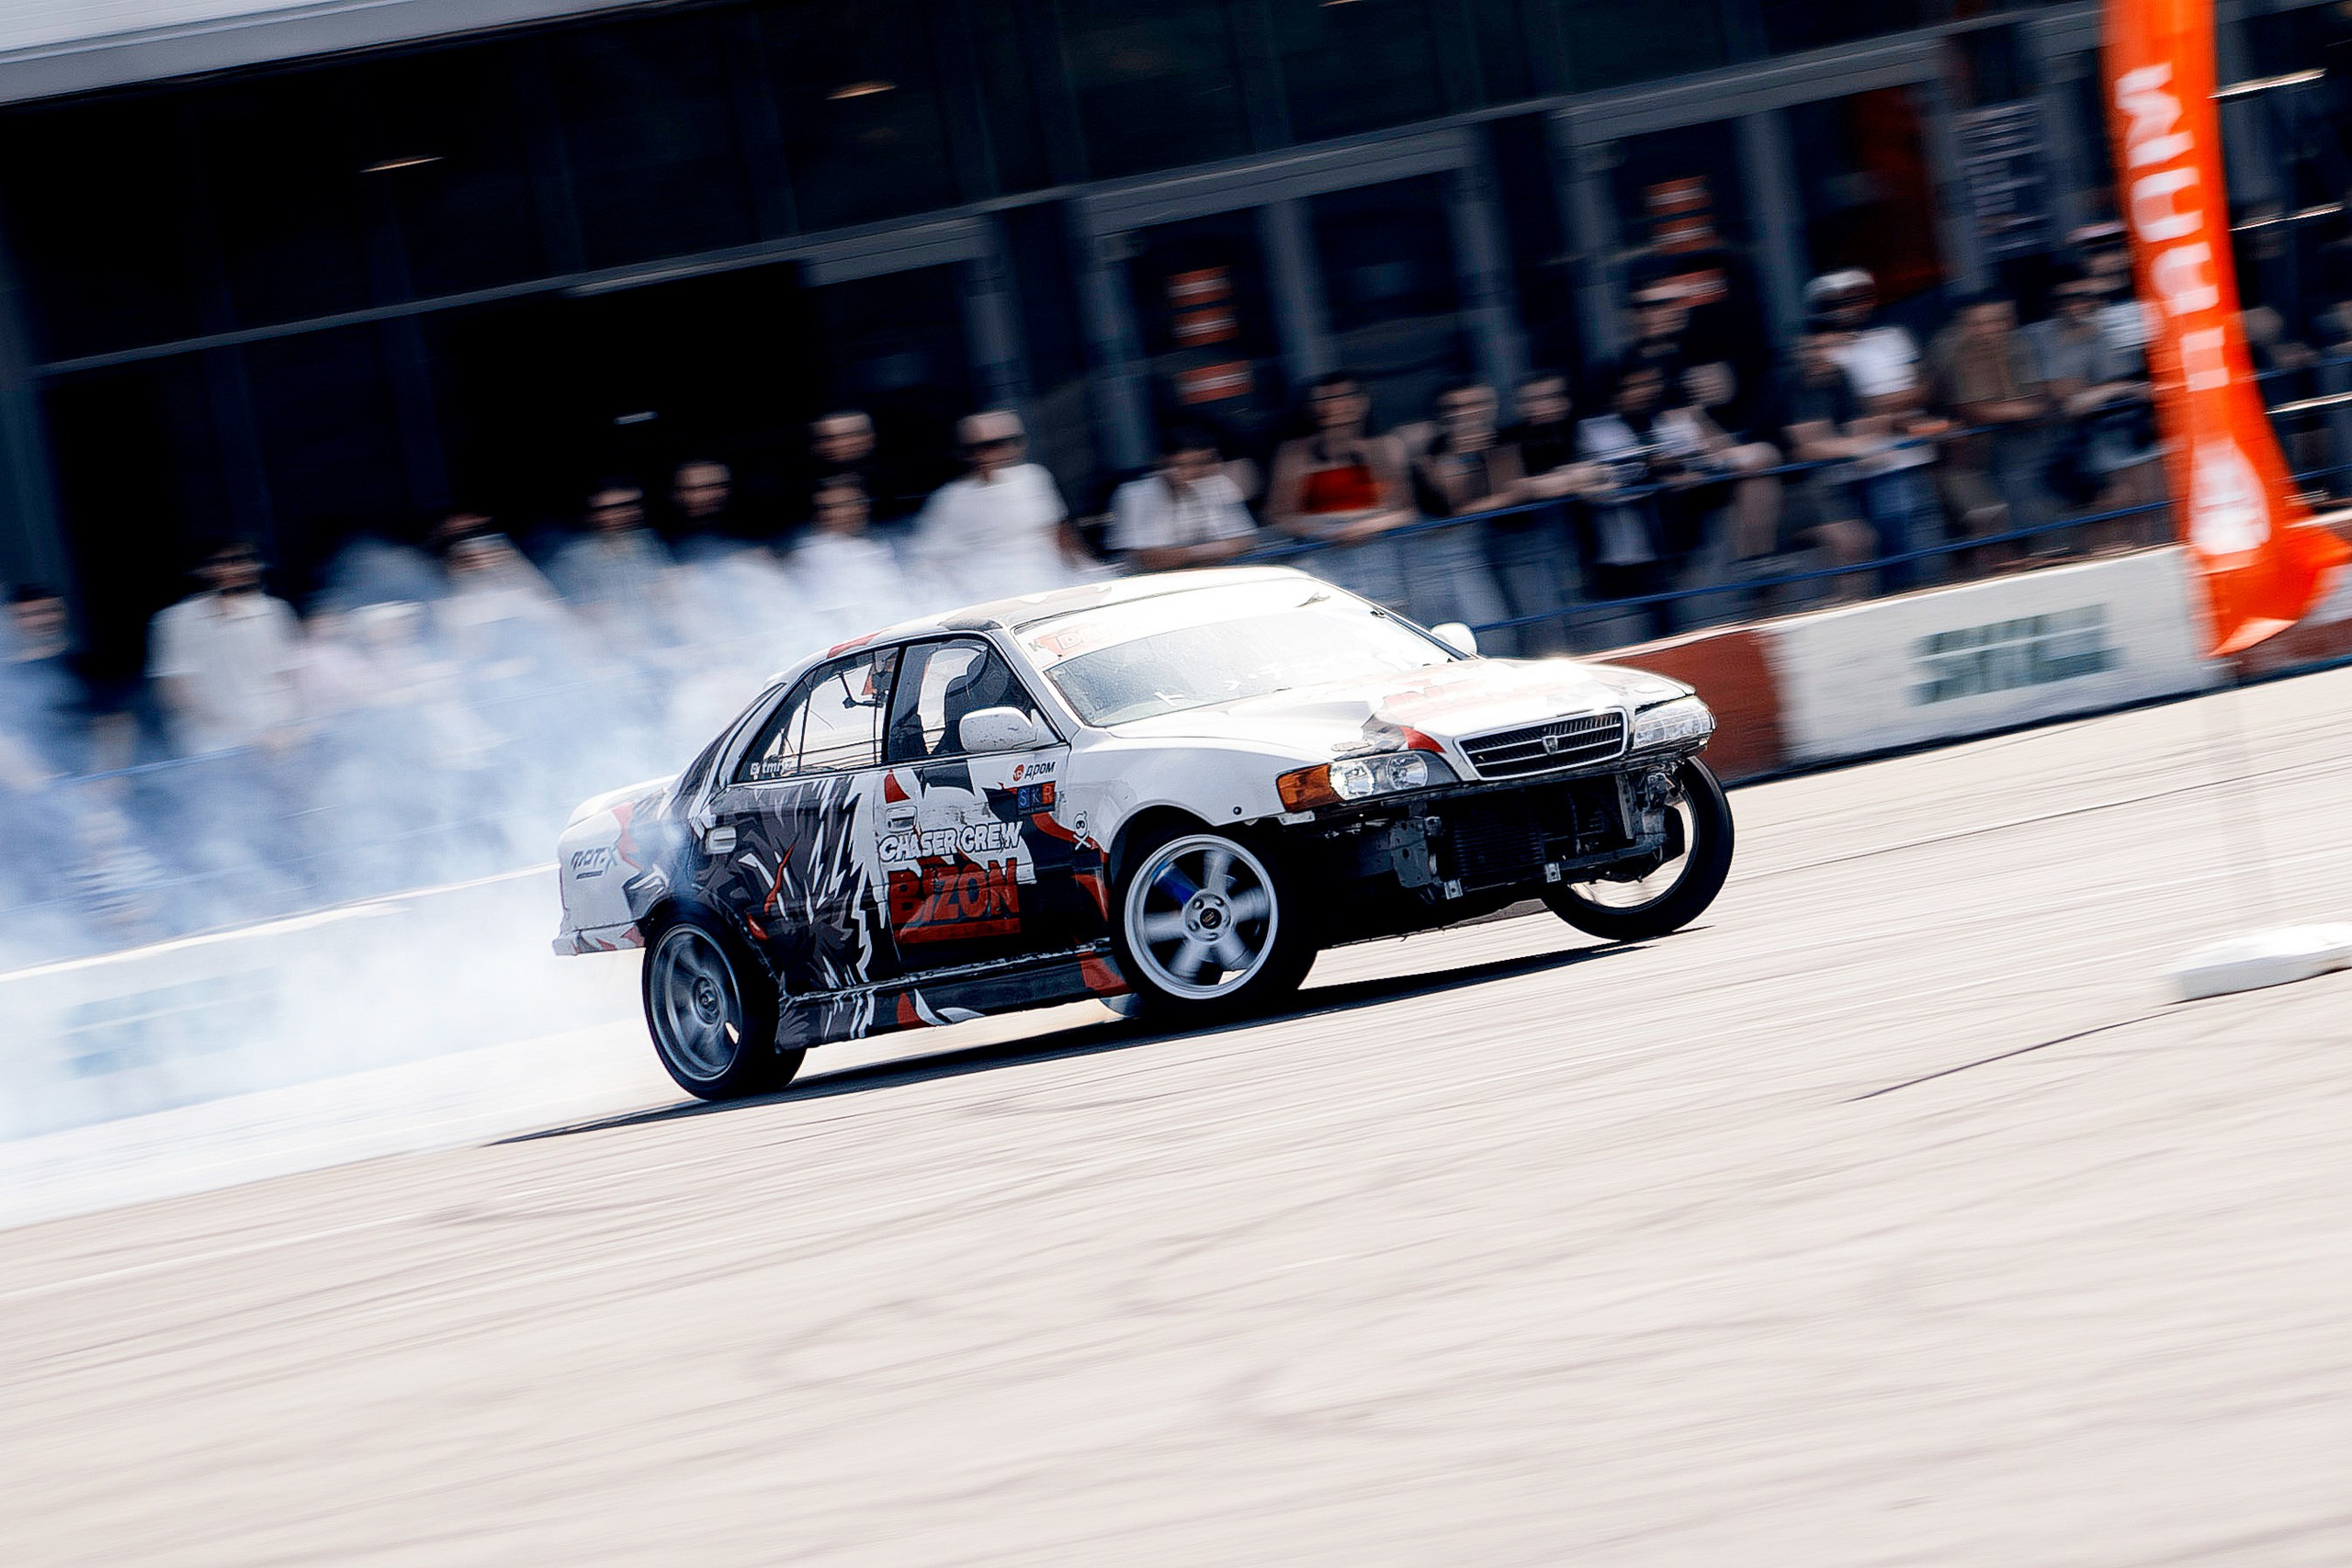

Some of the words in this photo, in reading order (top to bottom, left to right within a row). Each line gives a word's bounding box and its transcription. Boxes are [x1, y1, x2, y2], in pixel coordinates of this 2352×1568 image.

[1019, 785, 1054, 807] SKR
[879, 828, 958, 862] CHASER
[960, 821, 1023, 852] CREW
[888, 857, 1020, 924] BIZON
